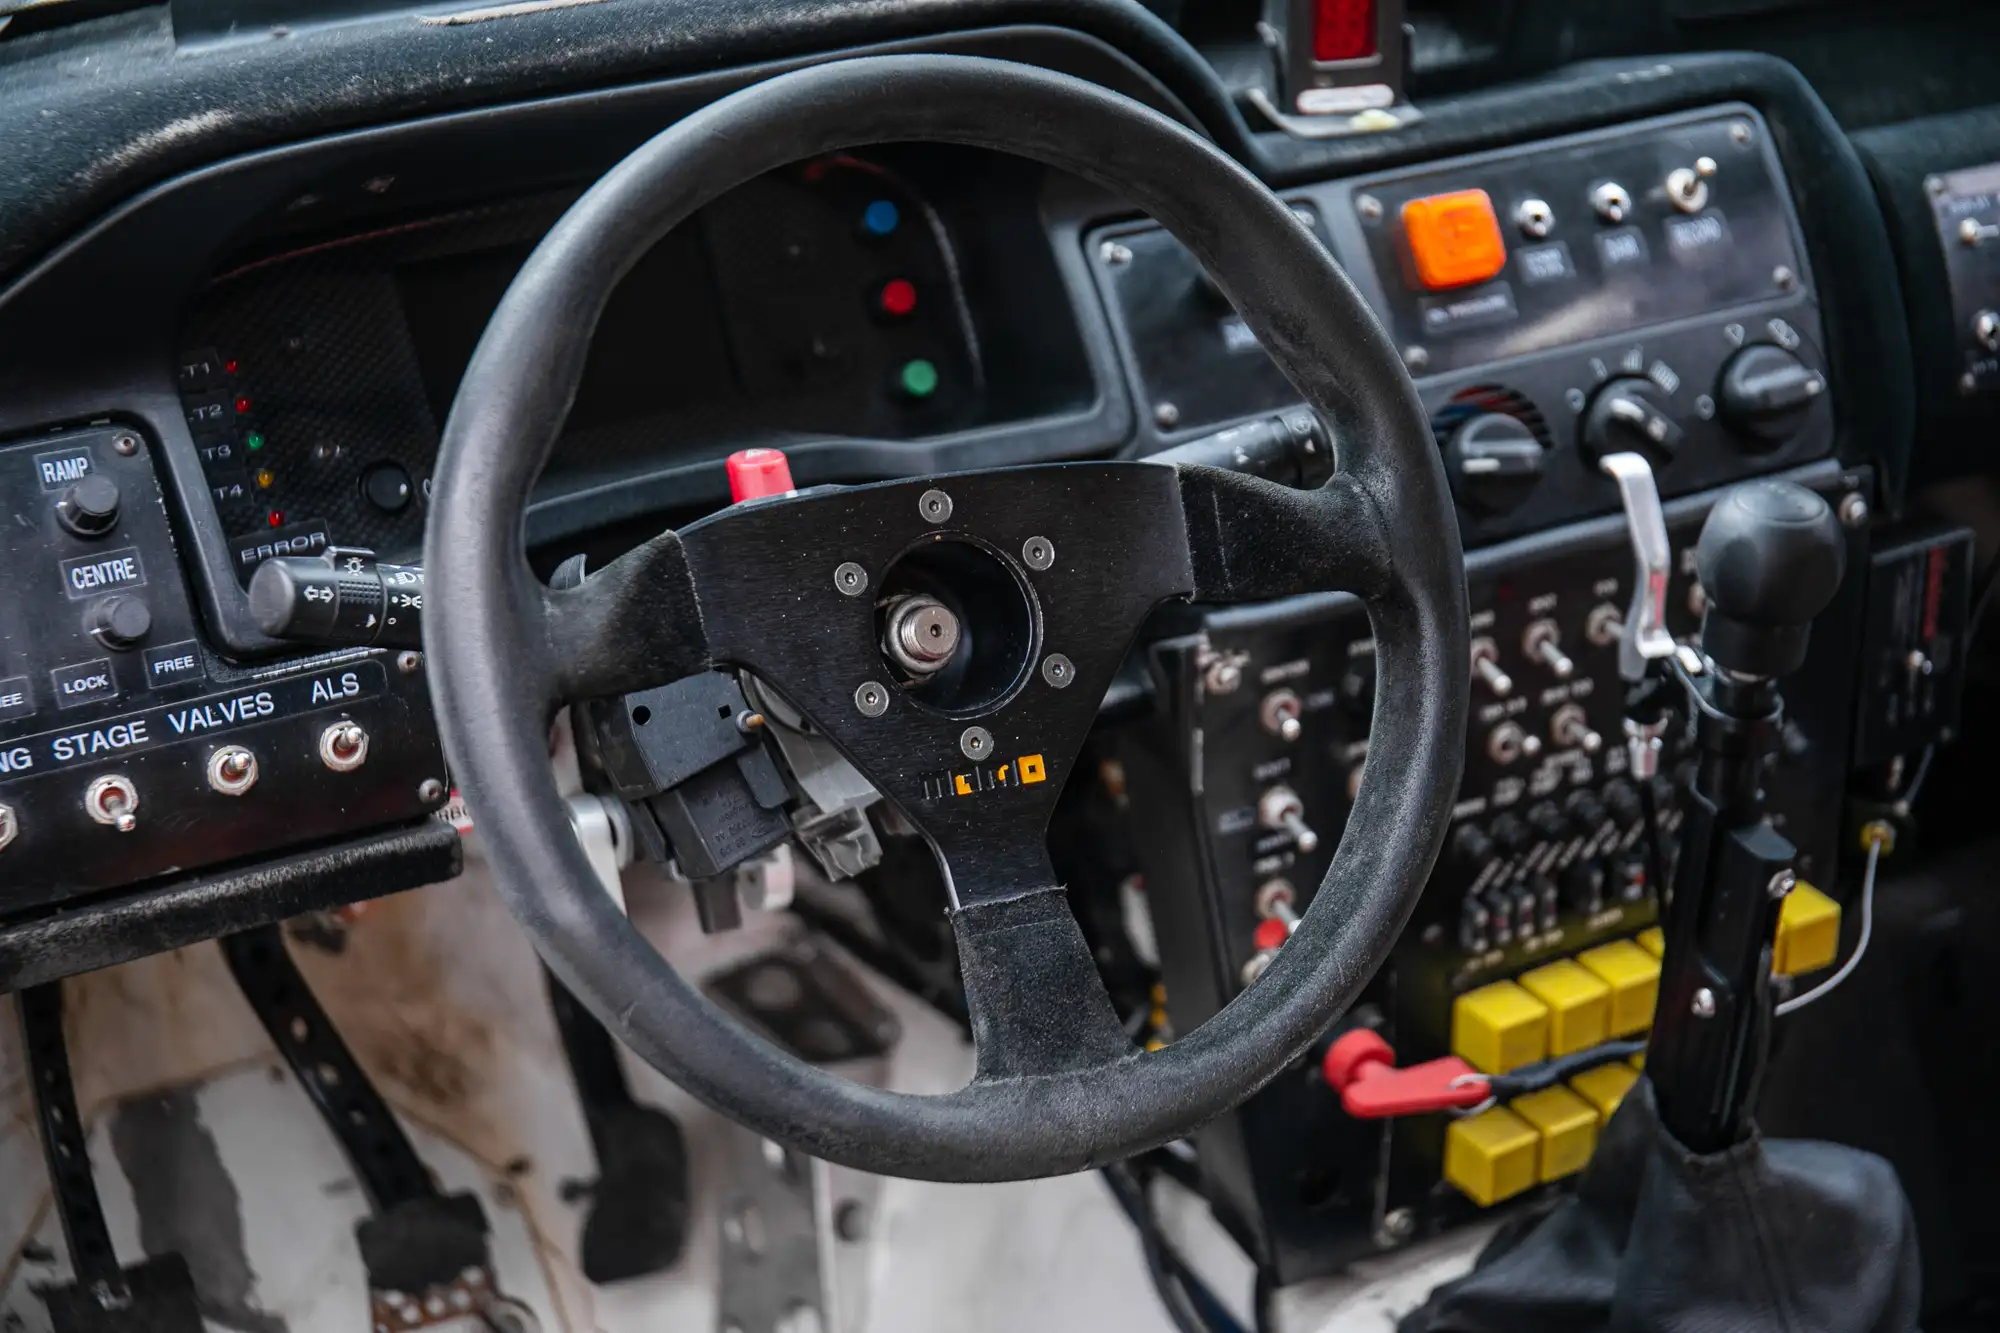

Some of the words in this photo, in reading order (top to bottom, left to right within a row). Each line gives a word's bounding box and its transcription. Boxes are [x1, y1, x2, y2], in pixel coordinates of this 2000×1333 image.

[42, 456, 89, 484] RAMP
[213, 483, 244, 501] T4
[240, 531, 327, 566] ERROR
[70, 557, 137, 590] CENTRE
[154, 654, 195, 674] FREE
[63, 673, 109, 694] LOCK
[52, 720, 150, 762] STAGE
[167, 692, 275, 734] VALVES
[310, 672, 360, 704] ALS
